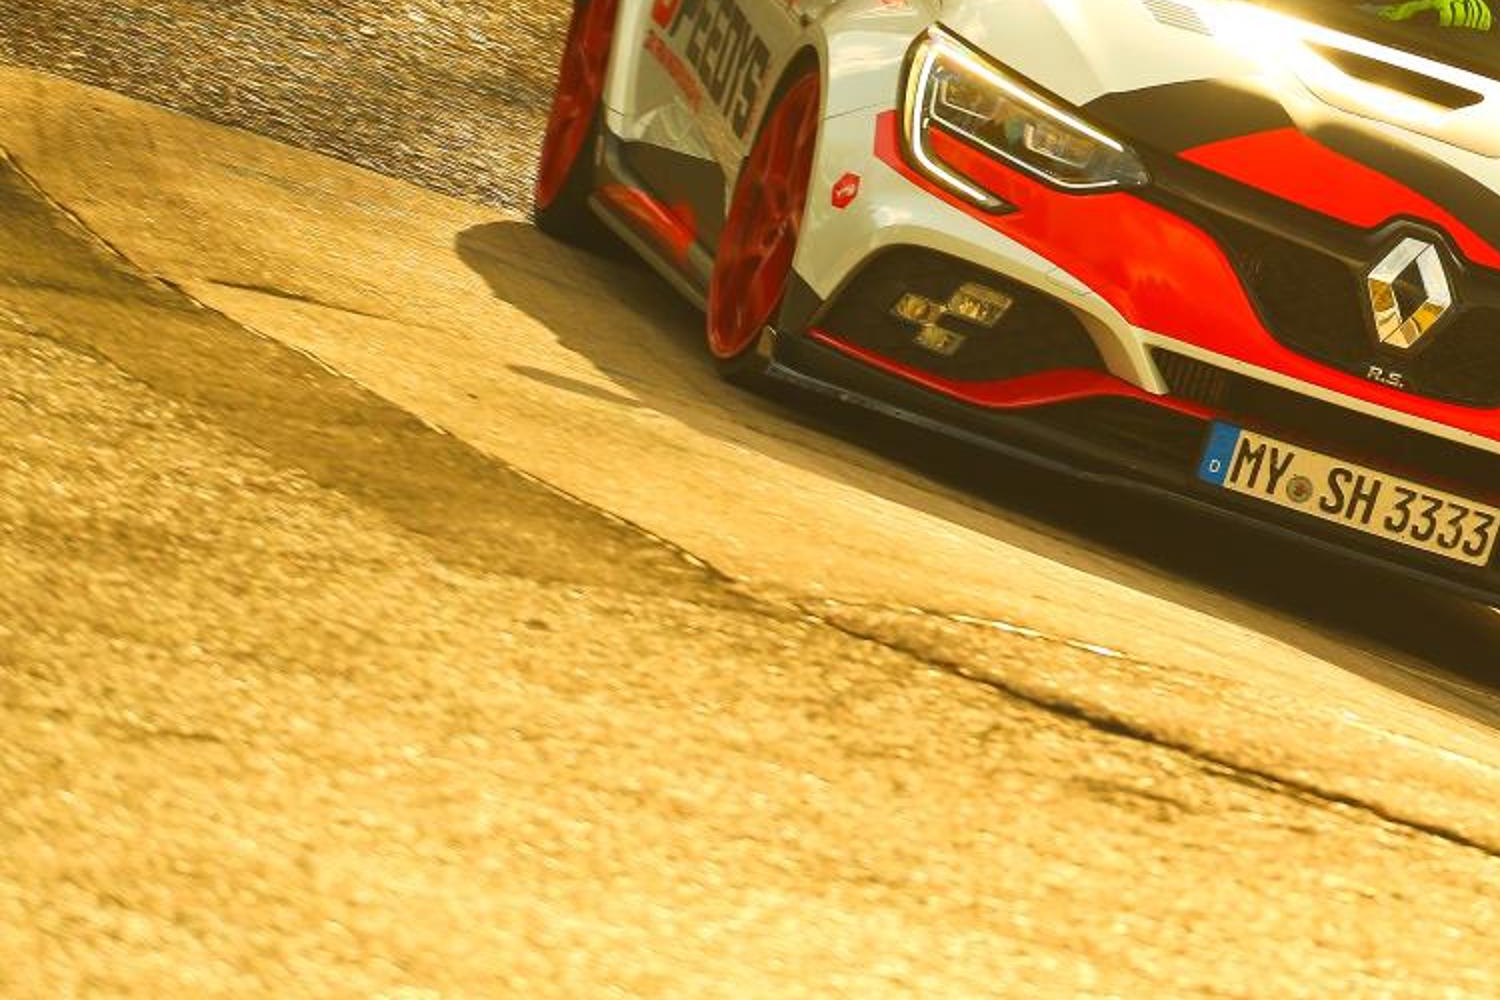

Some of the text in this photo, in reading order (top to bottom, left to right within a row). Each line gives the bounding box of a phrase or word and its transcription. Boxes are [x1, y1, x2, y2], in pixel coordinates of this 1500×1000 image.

[1367, 365, 1405, 388] R.S.
[1229, 437, 1496, 557] MY SH 3333
